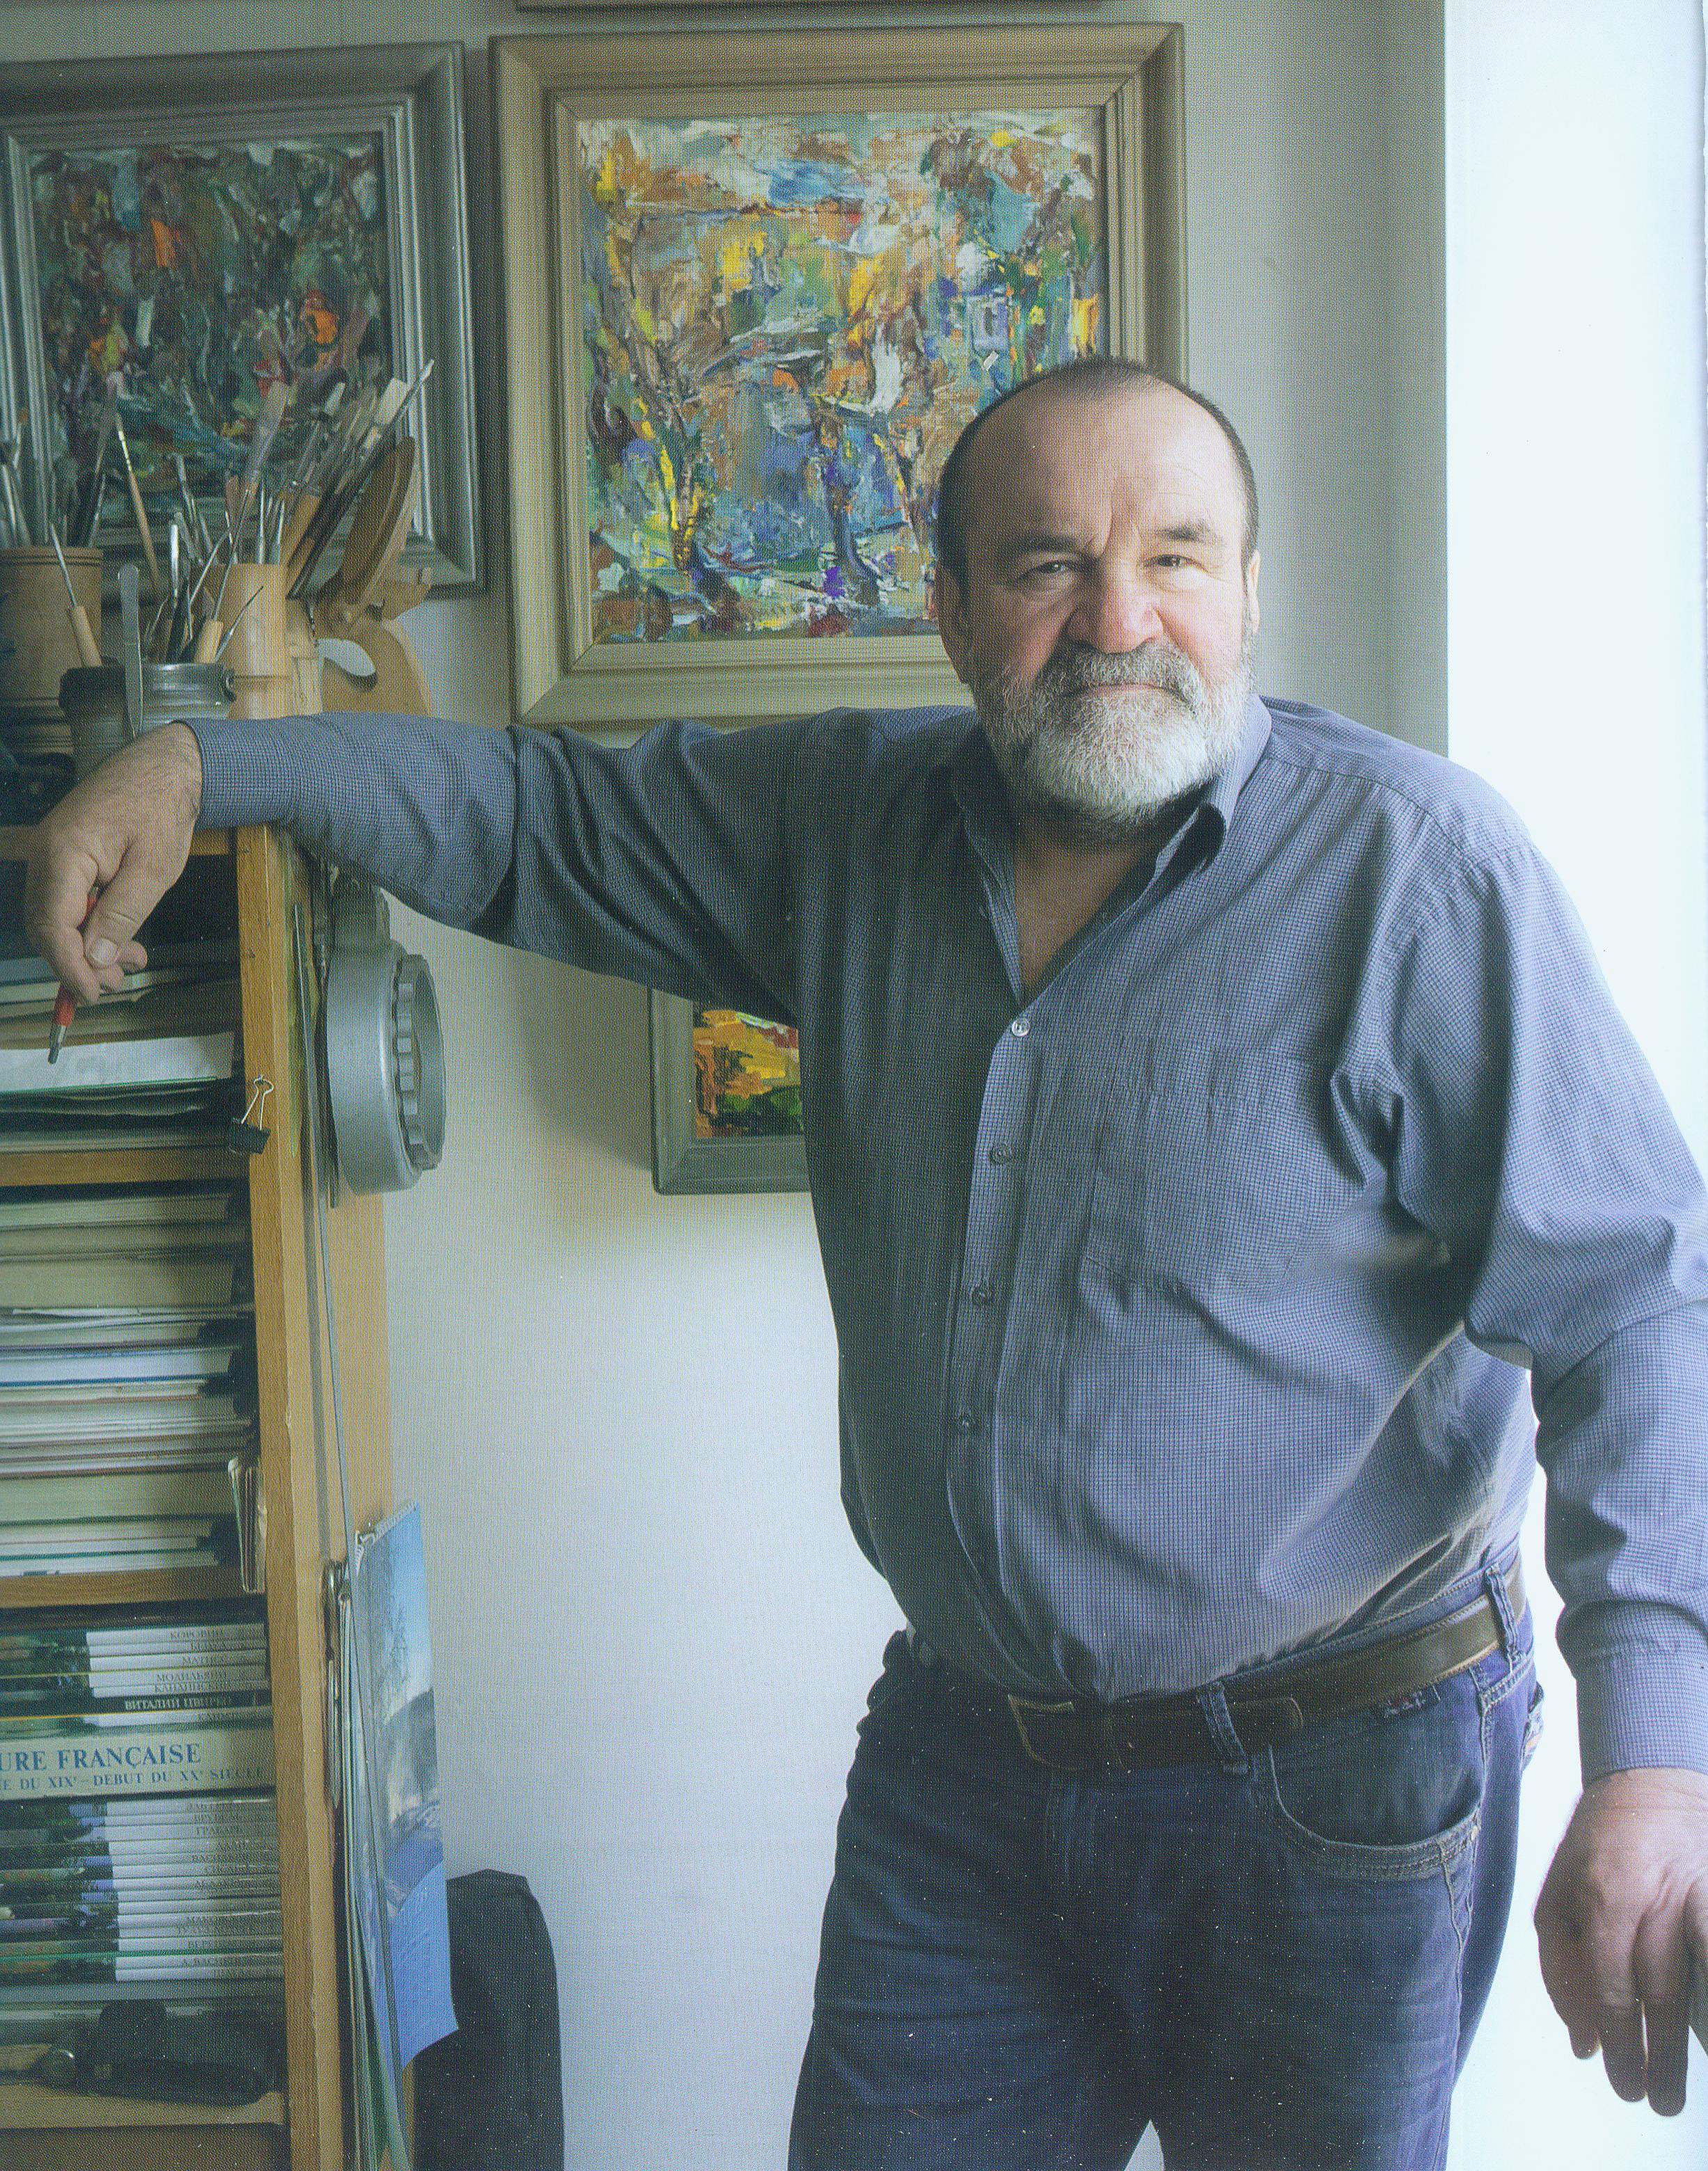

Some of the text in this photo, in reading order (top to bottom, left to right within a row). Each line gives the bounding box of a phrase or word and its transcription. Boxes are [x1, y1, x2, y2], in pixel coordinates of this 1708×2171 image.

[58, 1742, 202, 1768] FRANÇAISE
[20, 1779, 38, 1790] DU
[151, 1771, 172, 1783] DU
